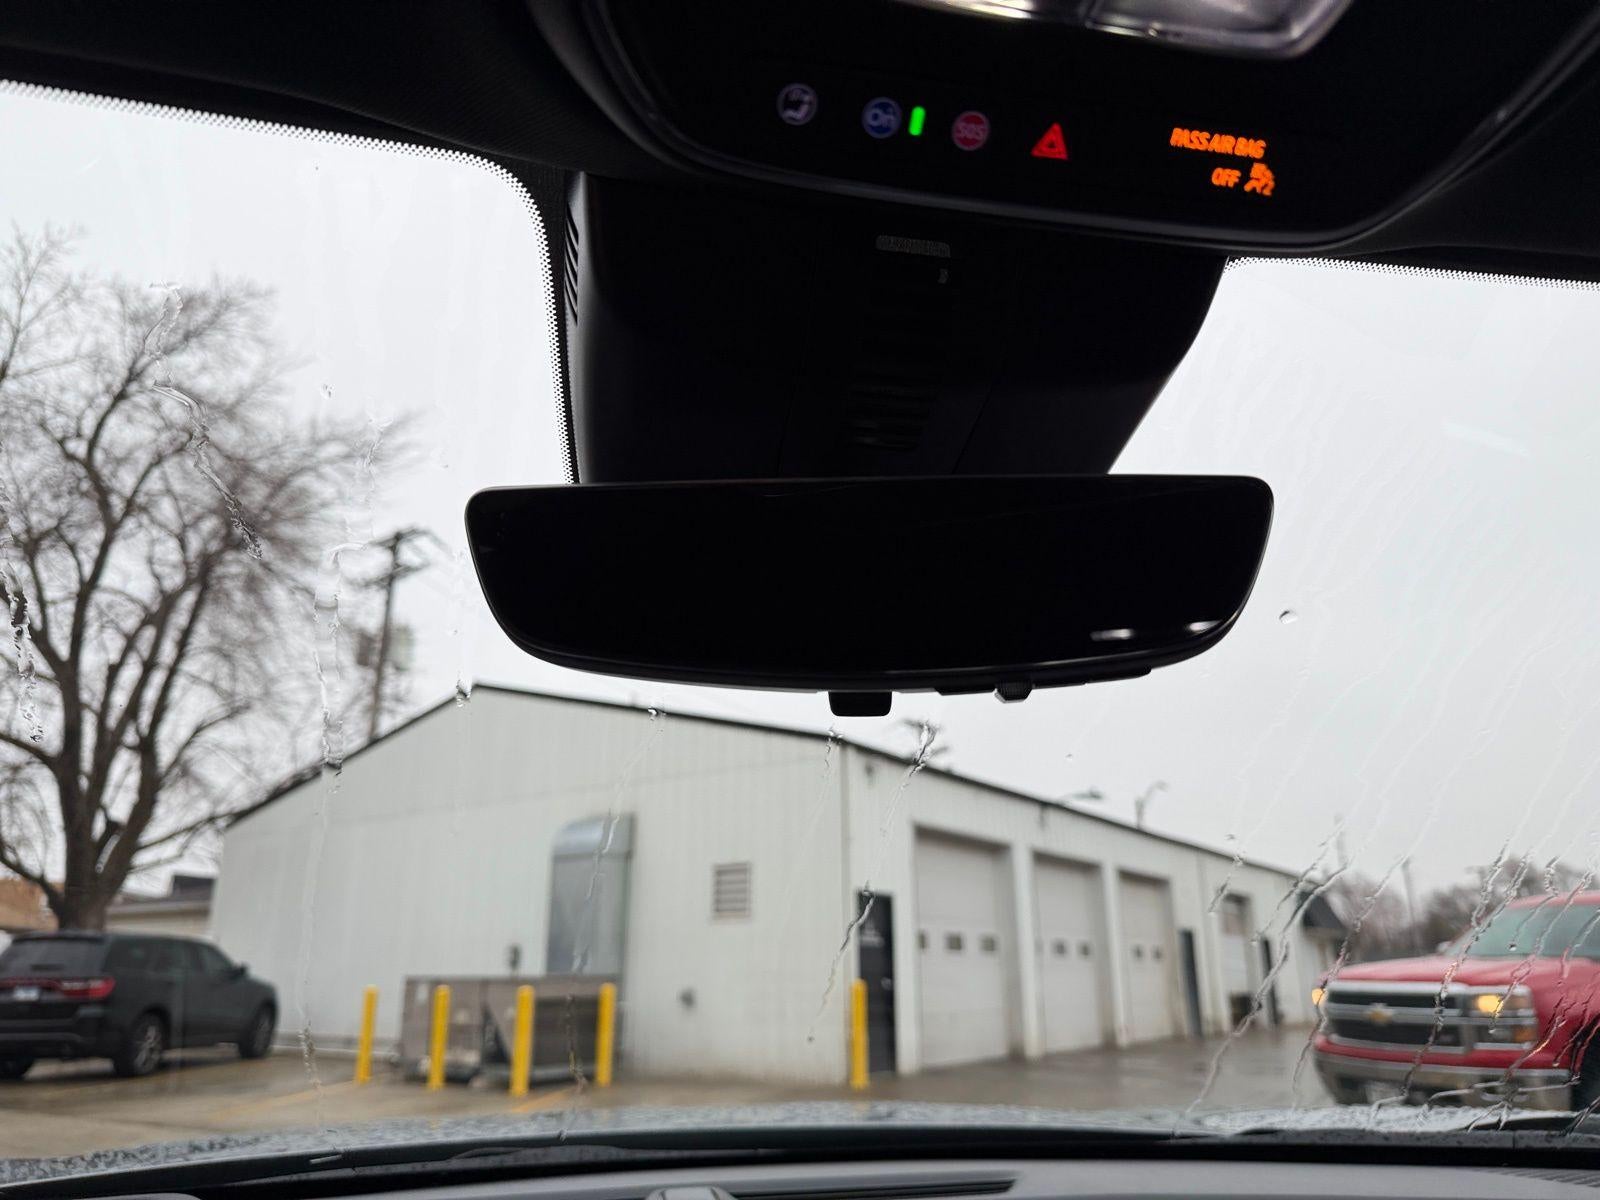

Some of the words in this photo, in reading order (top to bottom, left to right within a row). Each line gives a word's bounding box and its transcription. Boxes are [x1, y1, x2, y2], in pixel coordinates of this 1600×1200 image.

[956, 122, 986, 140] SOS
[1170, 127, 1210, 151] PASS
[1208, 133, 1236, 154] AIR
[1211, 167, 1241, 188] OFF
